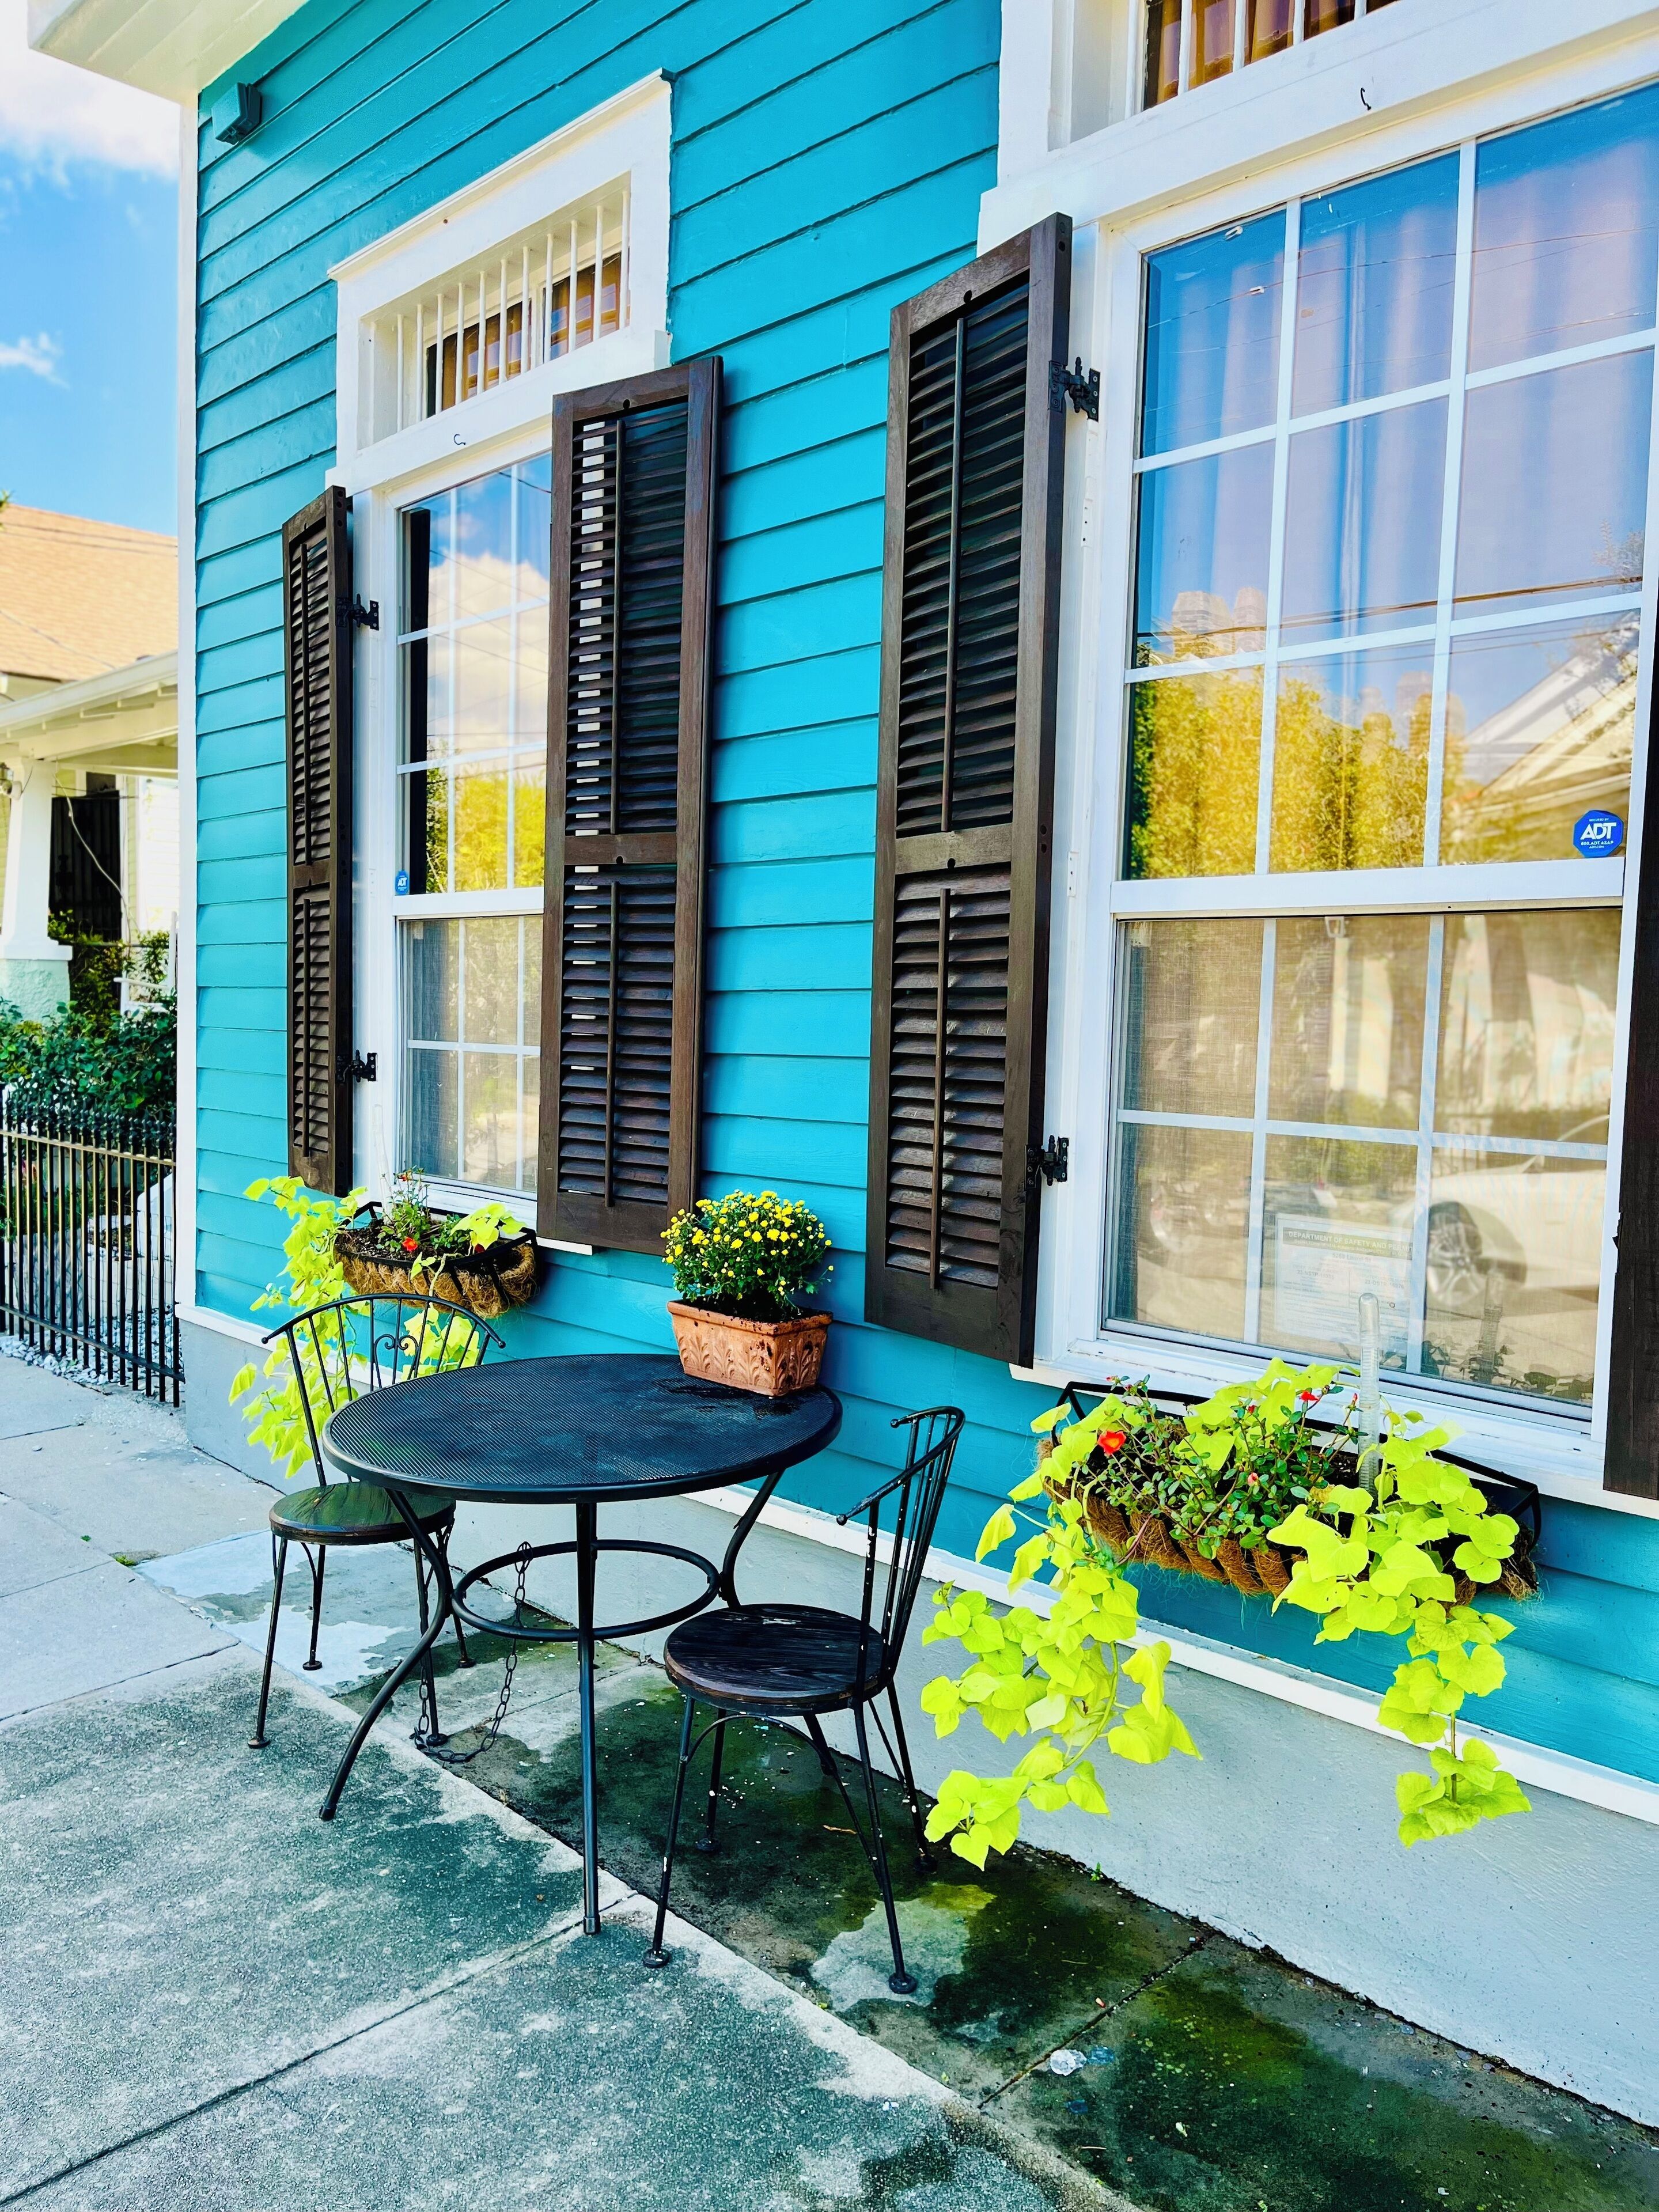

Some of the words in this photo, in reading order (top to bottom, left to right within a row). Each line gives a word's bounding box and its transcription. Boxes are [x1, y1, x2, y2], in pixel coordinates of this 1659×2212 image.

[1580, 822, 1617, 840] ADT
[397, 877, 407, 887] ADT
[1288, 1231, 1332, 1242] DEPARTMENT
[1344, 1238, 1370, 1247] SAFETY
[1372, 1241, 1387, 1249] AND
